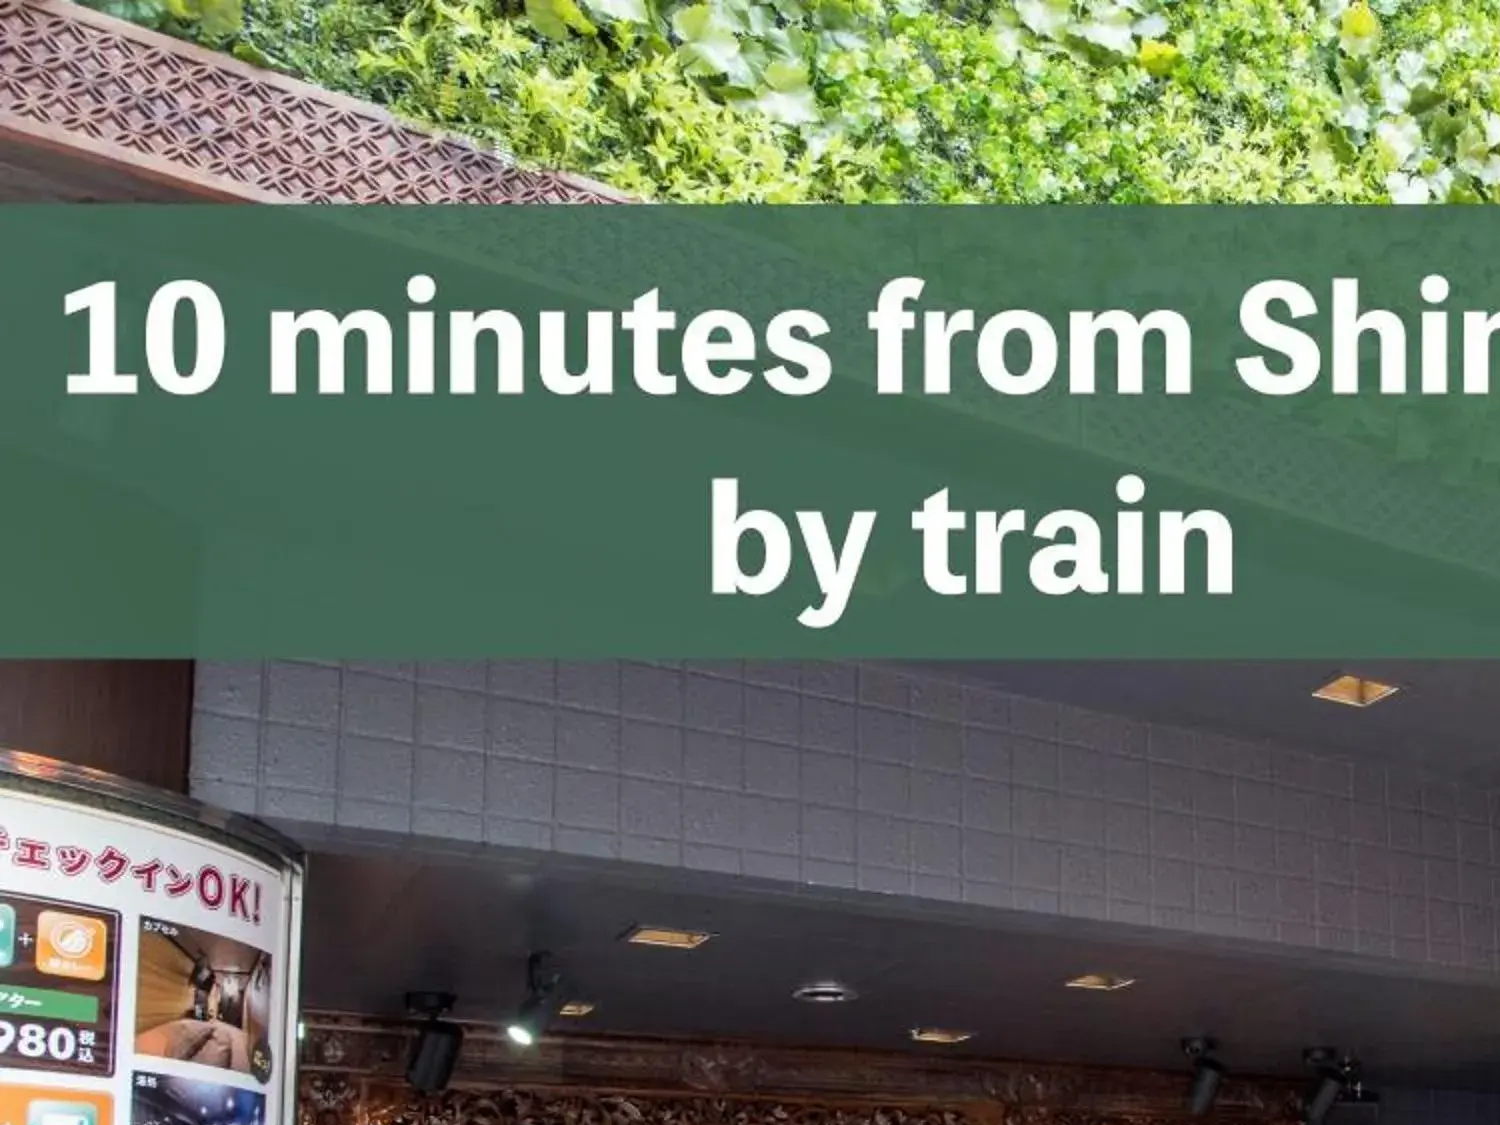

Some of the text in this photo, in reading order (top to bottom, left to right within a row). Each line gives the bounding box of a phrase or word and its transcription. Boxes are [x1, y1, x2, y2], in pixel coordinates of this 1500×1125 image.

[0, 832, 262, 925] ェックインOK!
